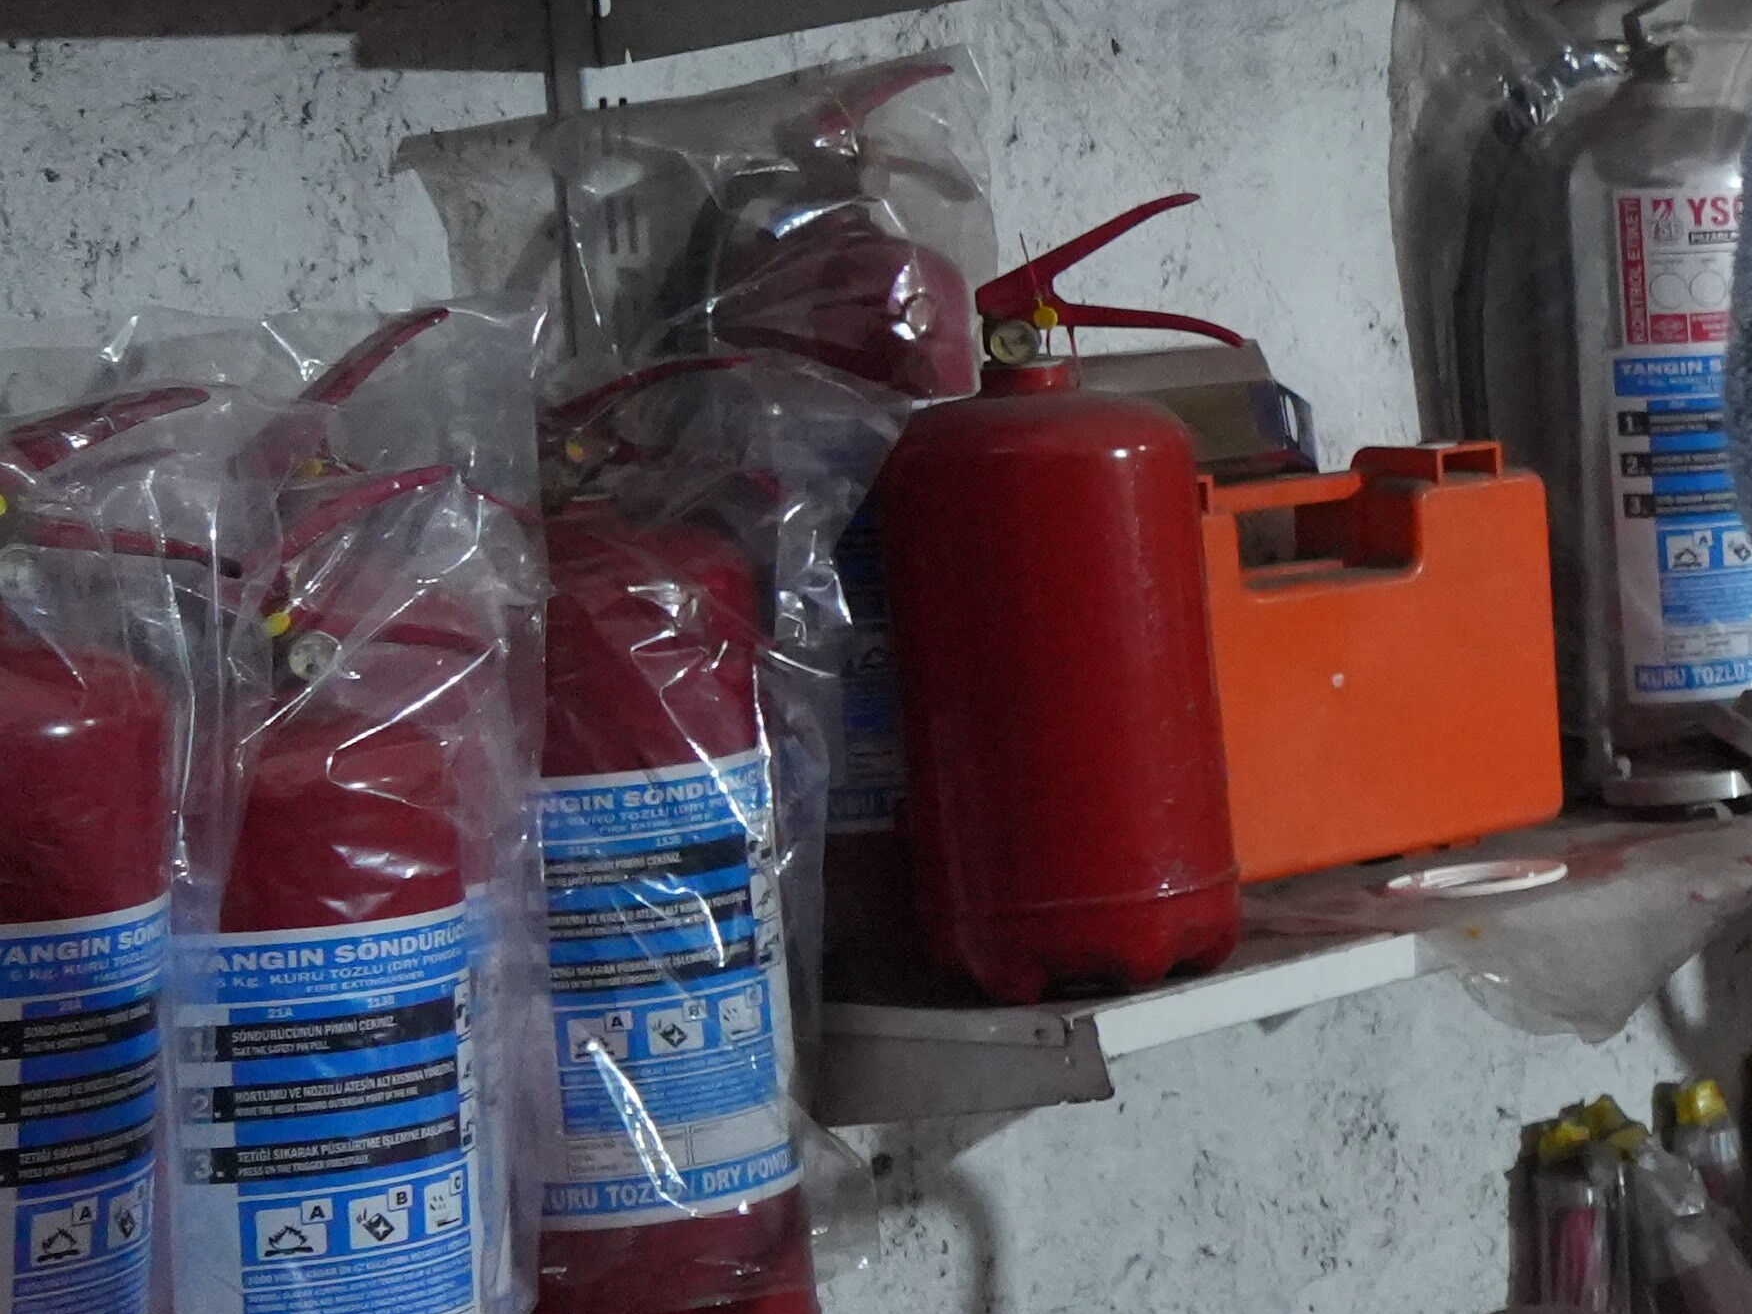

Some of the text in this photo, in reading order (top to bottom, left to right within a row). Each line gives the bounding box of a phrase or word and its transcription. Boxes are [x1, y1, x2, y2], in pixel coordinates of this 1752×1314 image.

[1622, 360, 1704, 376] YANGIN
[541, 792, 614, 814] NGIN
[206, 920, 466, 974] ANGIN SÖNDÜRÜ
[270, 971, 325, 985] KURU
[330, 962, 383, 979] TOZLU
[612, 1016, 624, 1029] A
[545, 1187, 598, 1212] URU
[702, 1166, 743, 1195] DRY
[396, 1190, 408, 1205] B
[80, 1206, 92, 1221] A
[309, 1205, 325, 1221] A
